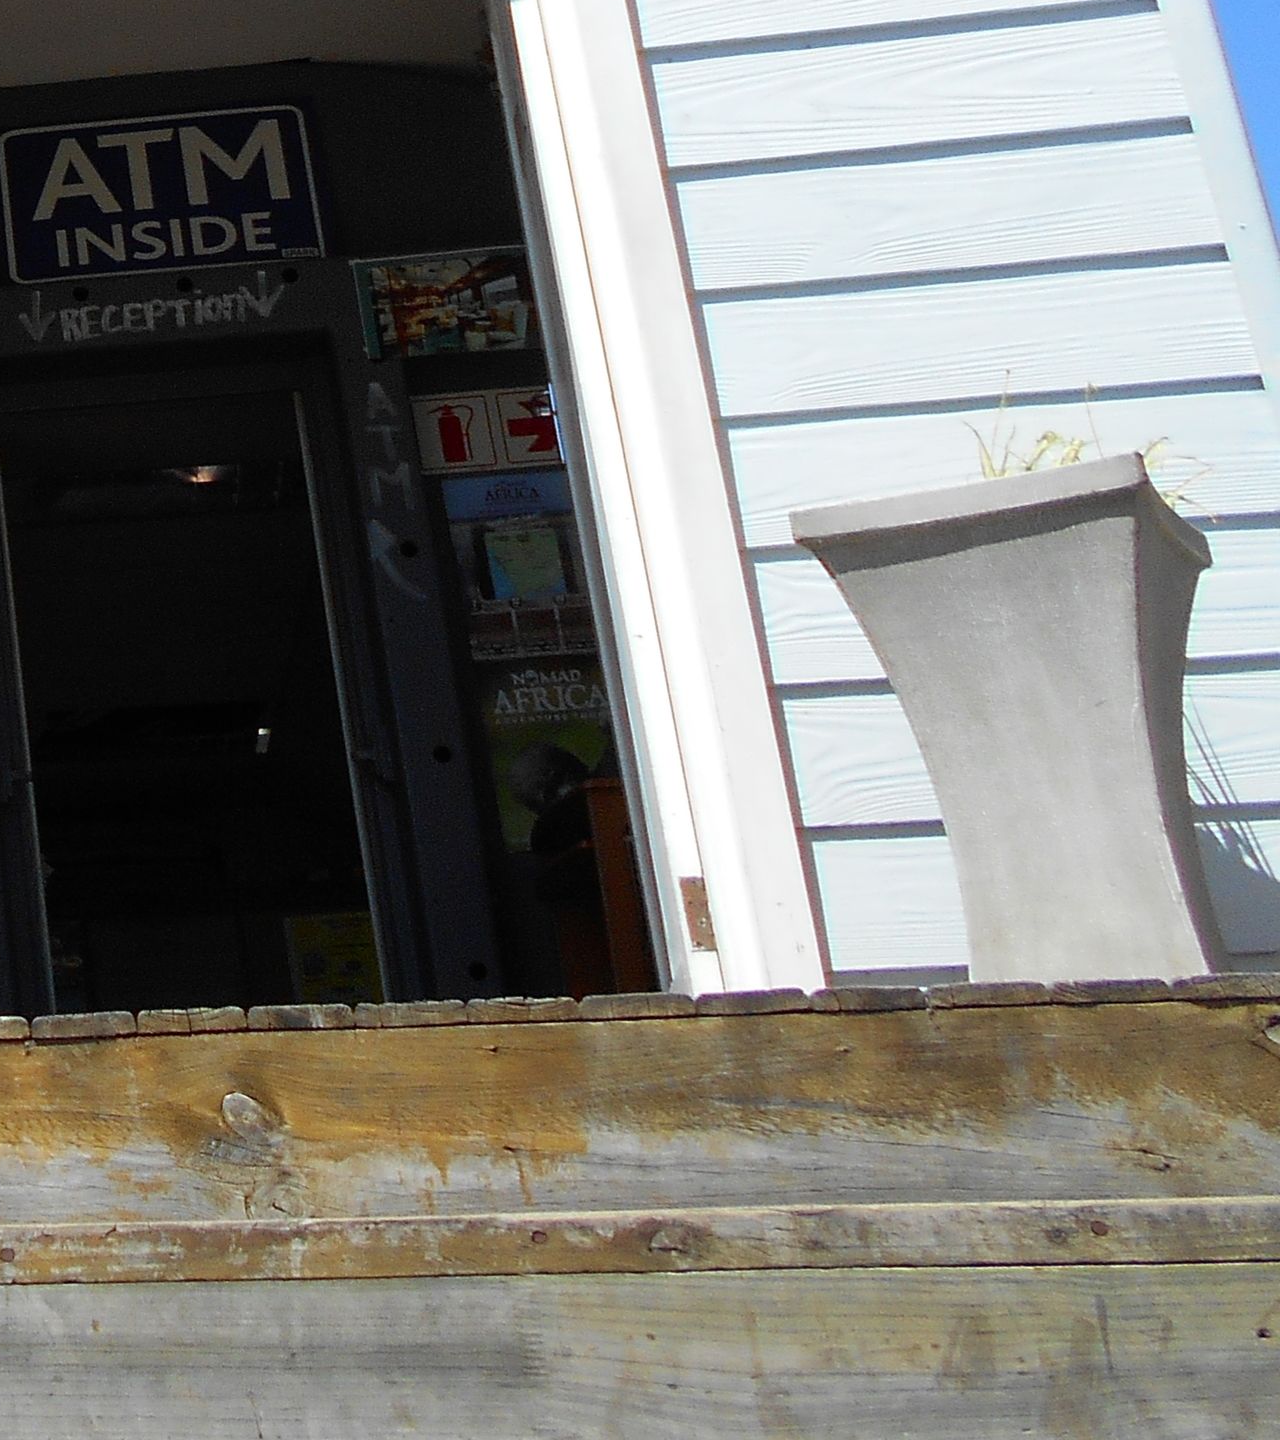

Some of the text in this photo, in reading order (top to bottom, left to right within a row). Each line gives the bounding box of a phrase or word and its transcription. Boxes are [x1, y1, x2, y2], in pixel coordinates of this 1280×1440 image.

[32, 118, 292, 222] ATM
[55, 210, 277, 267] INSIDE
[493, 683, 609, 715] AFRICA
